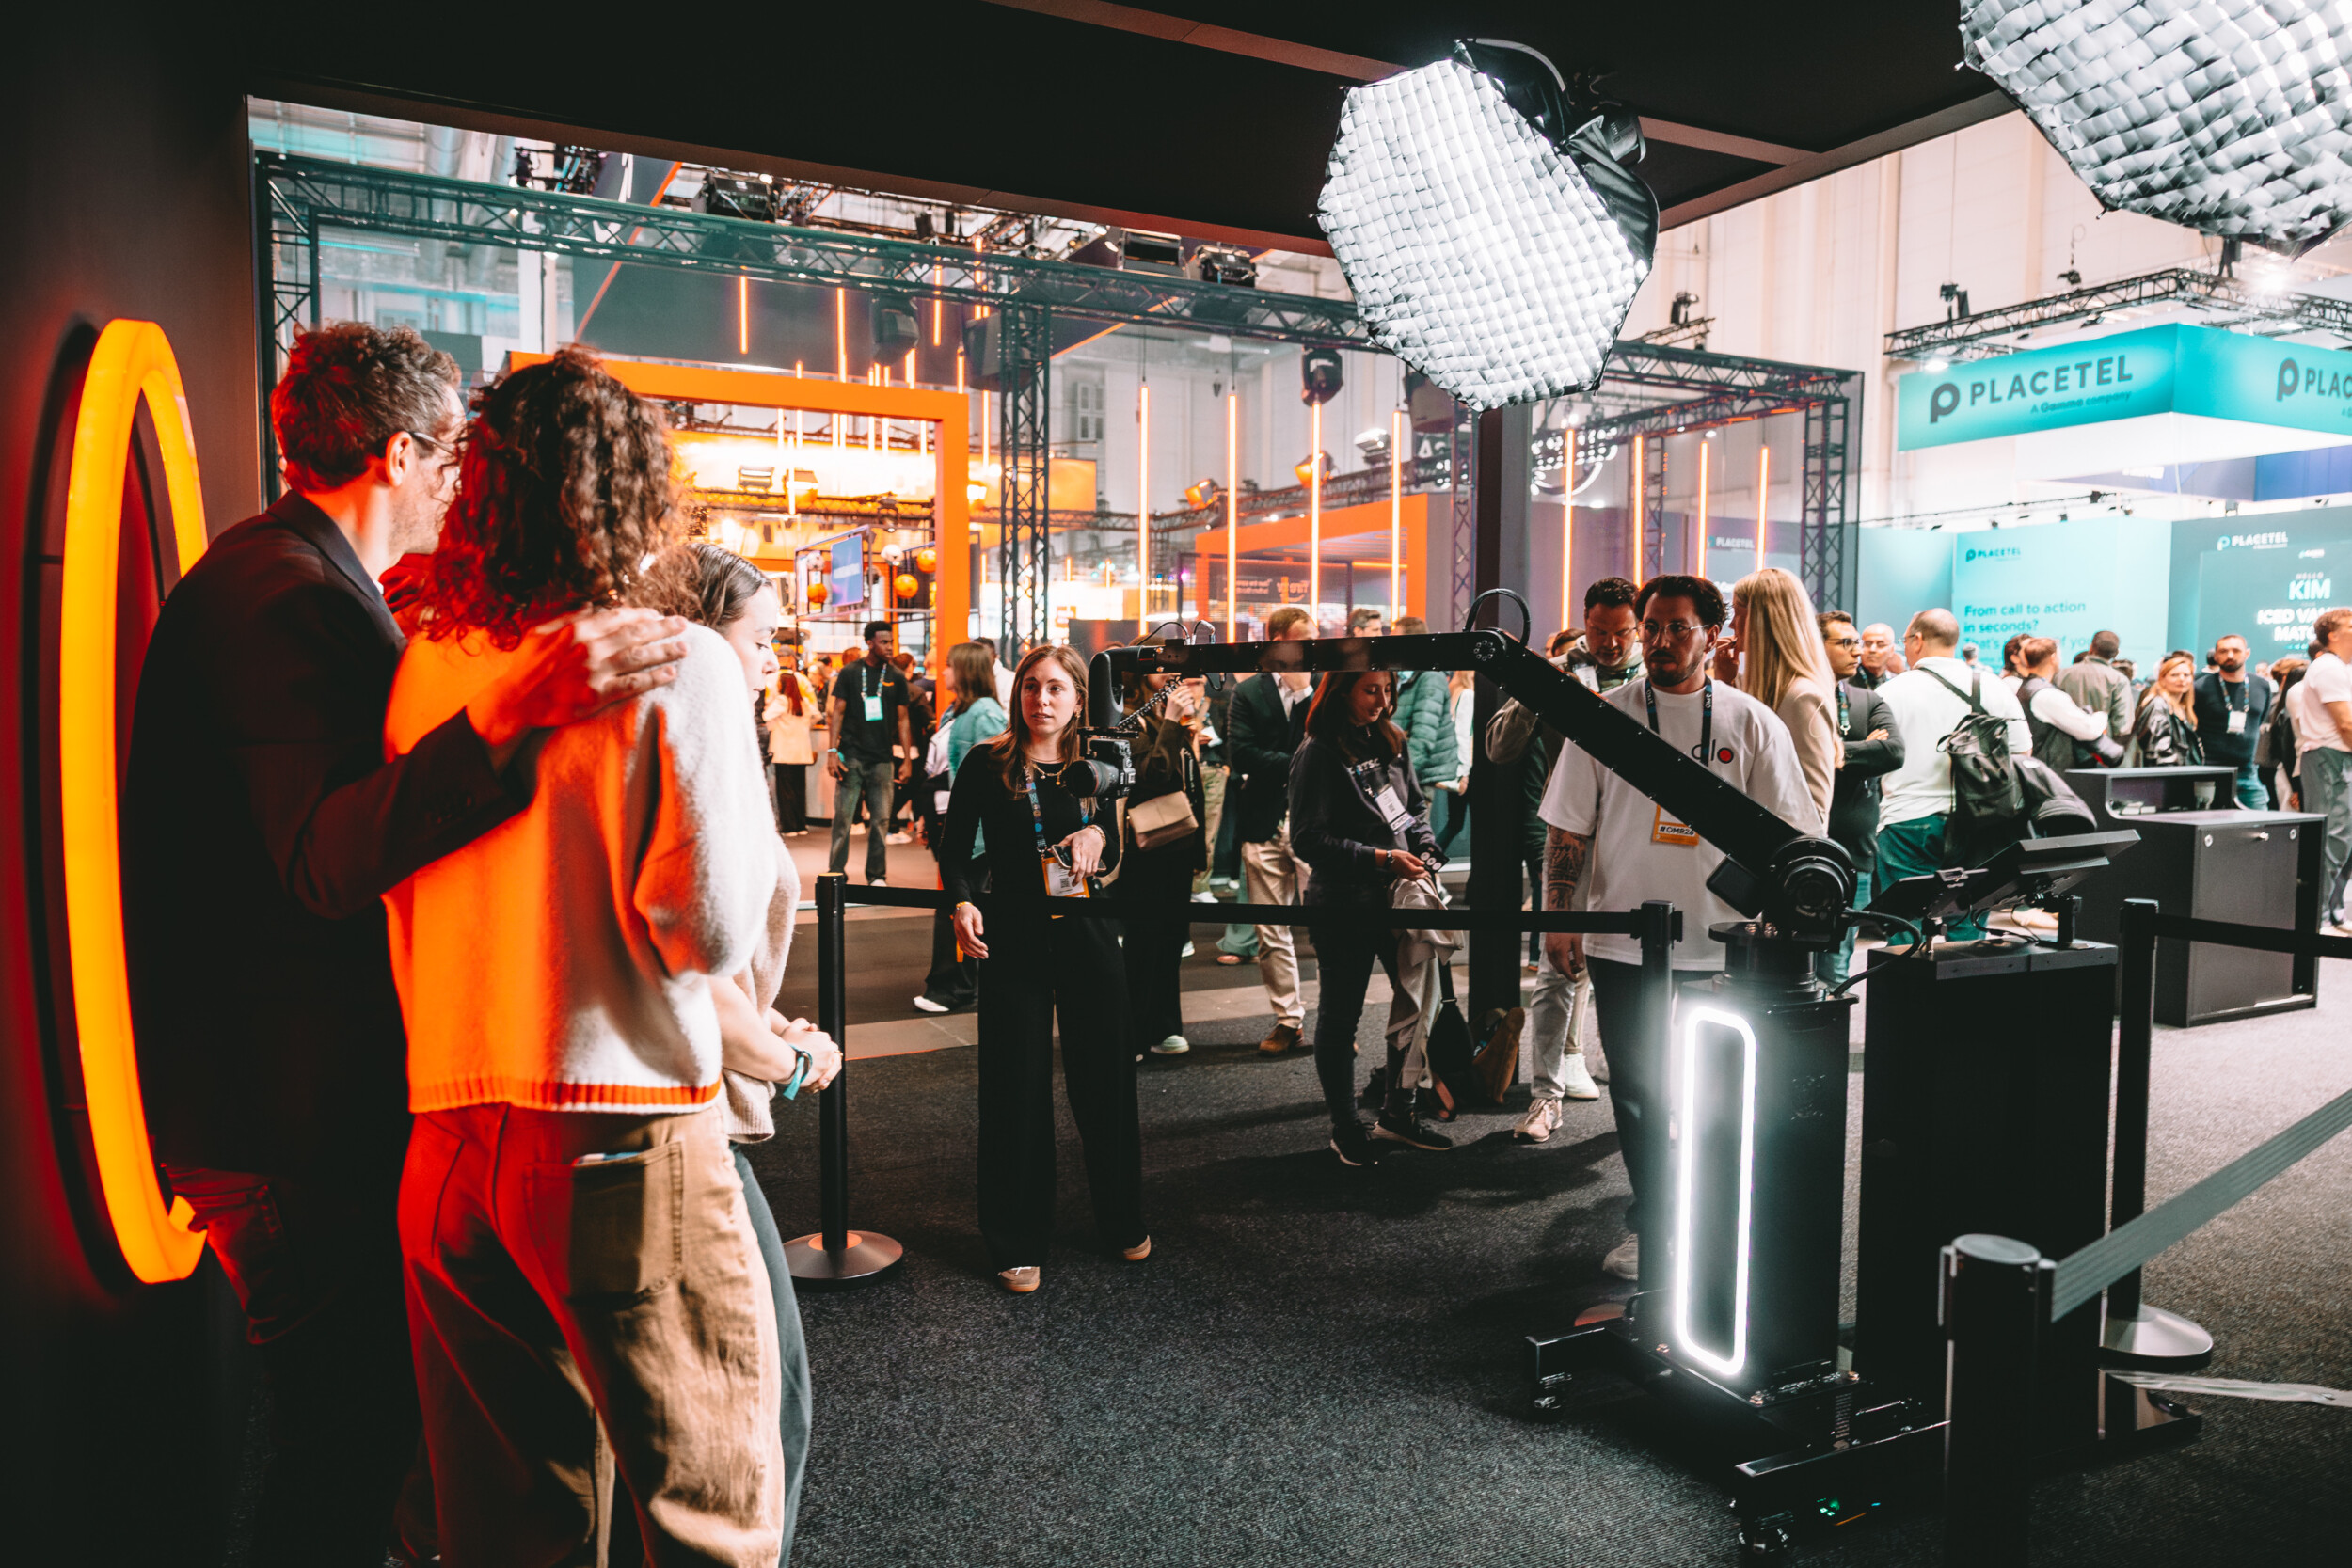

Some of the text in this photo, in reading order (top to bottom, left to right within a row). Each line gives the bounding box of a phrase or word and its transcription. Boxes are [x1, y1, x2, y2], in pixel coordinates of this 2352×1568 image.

[1969, 355, 2134, 406] PLACETEL
[2041, 398, 2084, 414] Gamma
[2086, 390, 2133, 407] company
[1715, 536, 1755, 549] PLACETEL
[2231, 531, 2288, 546] PLACETEL
[1977, 547, 2021, 558] PLACETEL
[2288, 578, 2331, 600] KIM
[1964, 600, 2086, 617] From call to action
[2256, 608, 2296, 625] ICED
[1963, 619, 2039, 633] in seconds?
